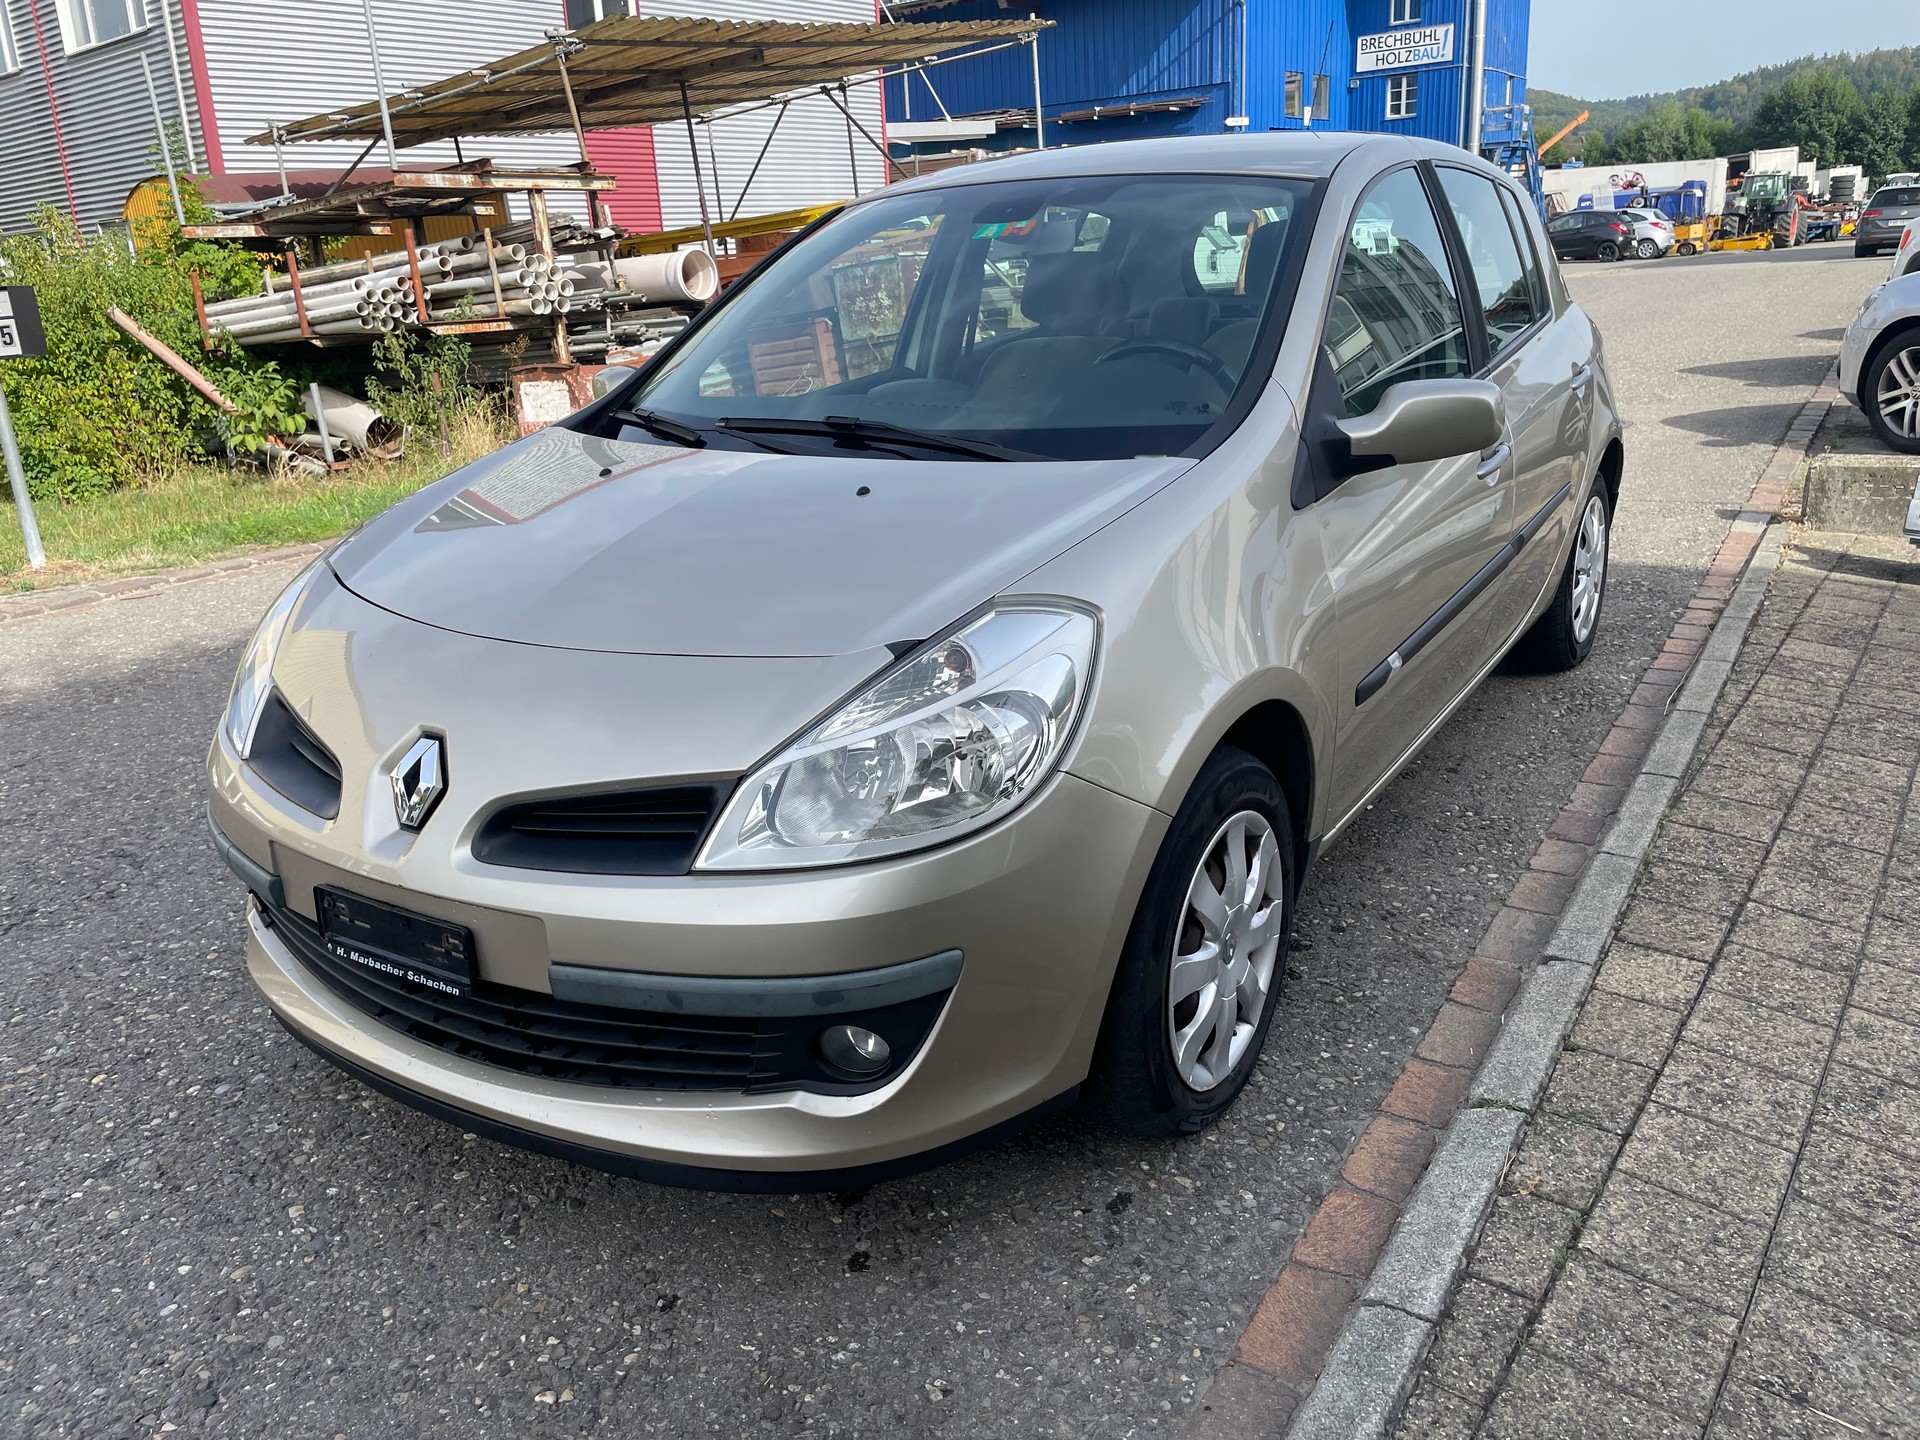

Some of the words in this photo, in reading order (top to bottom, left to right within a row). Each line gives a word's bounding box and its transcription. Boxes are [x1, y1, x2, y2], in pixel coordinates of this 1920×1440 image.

[1361, 29, 1440, 51] BRECHBÜHL
[336, 946, 347, 958] H.
[350, 951, 404, 977] Marbacher
[407, 970, 460, 996] Schachen
